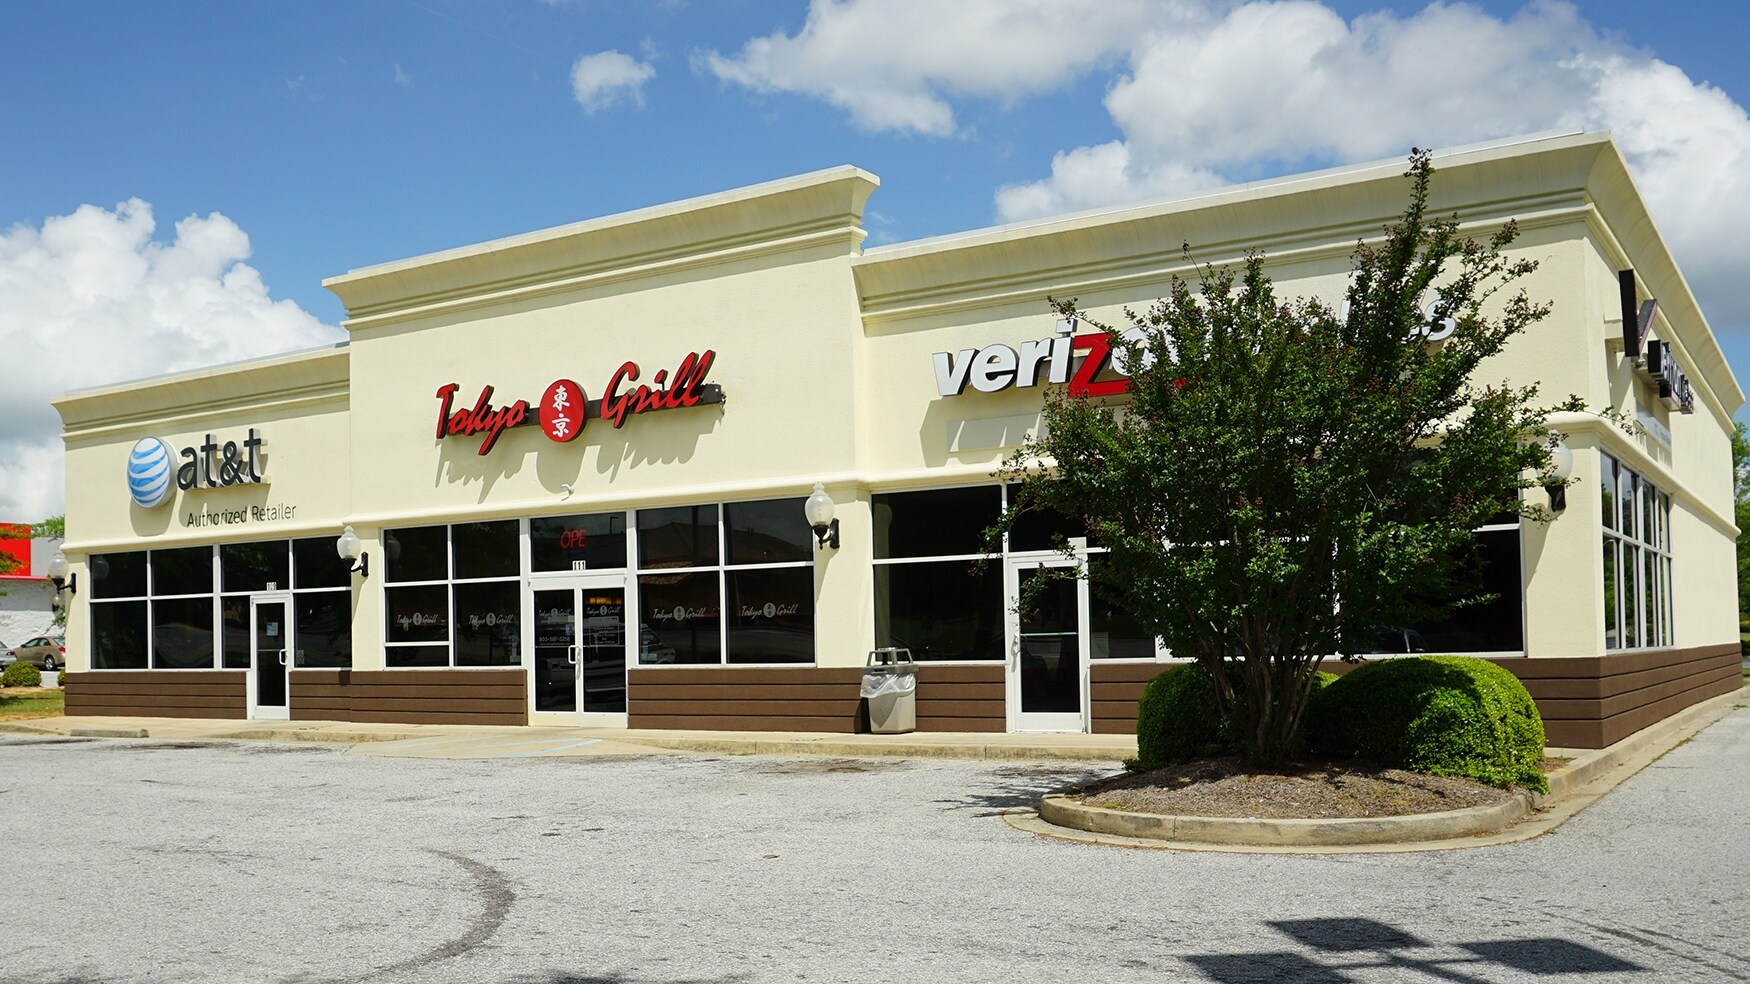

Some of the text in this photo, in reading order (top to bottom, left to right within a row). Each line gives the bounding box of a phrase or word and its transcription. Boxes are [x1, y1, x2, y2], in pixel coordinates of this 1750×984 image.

[436, 349, 716, 456] Tokyo Grill
[551, 385, 571, 438] 東京
[177, 428, 262, 491] at&t
[187, 503, 297, 528] Authorized Retailer
[573, 561, 586, 570] 111
[496, 613, 514, 625] Grill
[652, 608, 673, 622] Tokyo
[685, 606, 707, 620] Grill
[741, 605, 763, 620] Tokyo
[776, 603, 799, 617] Grill
